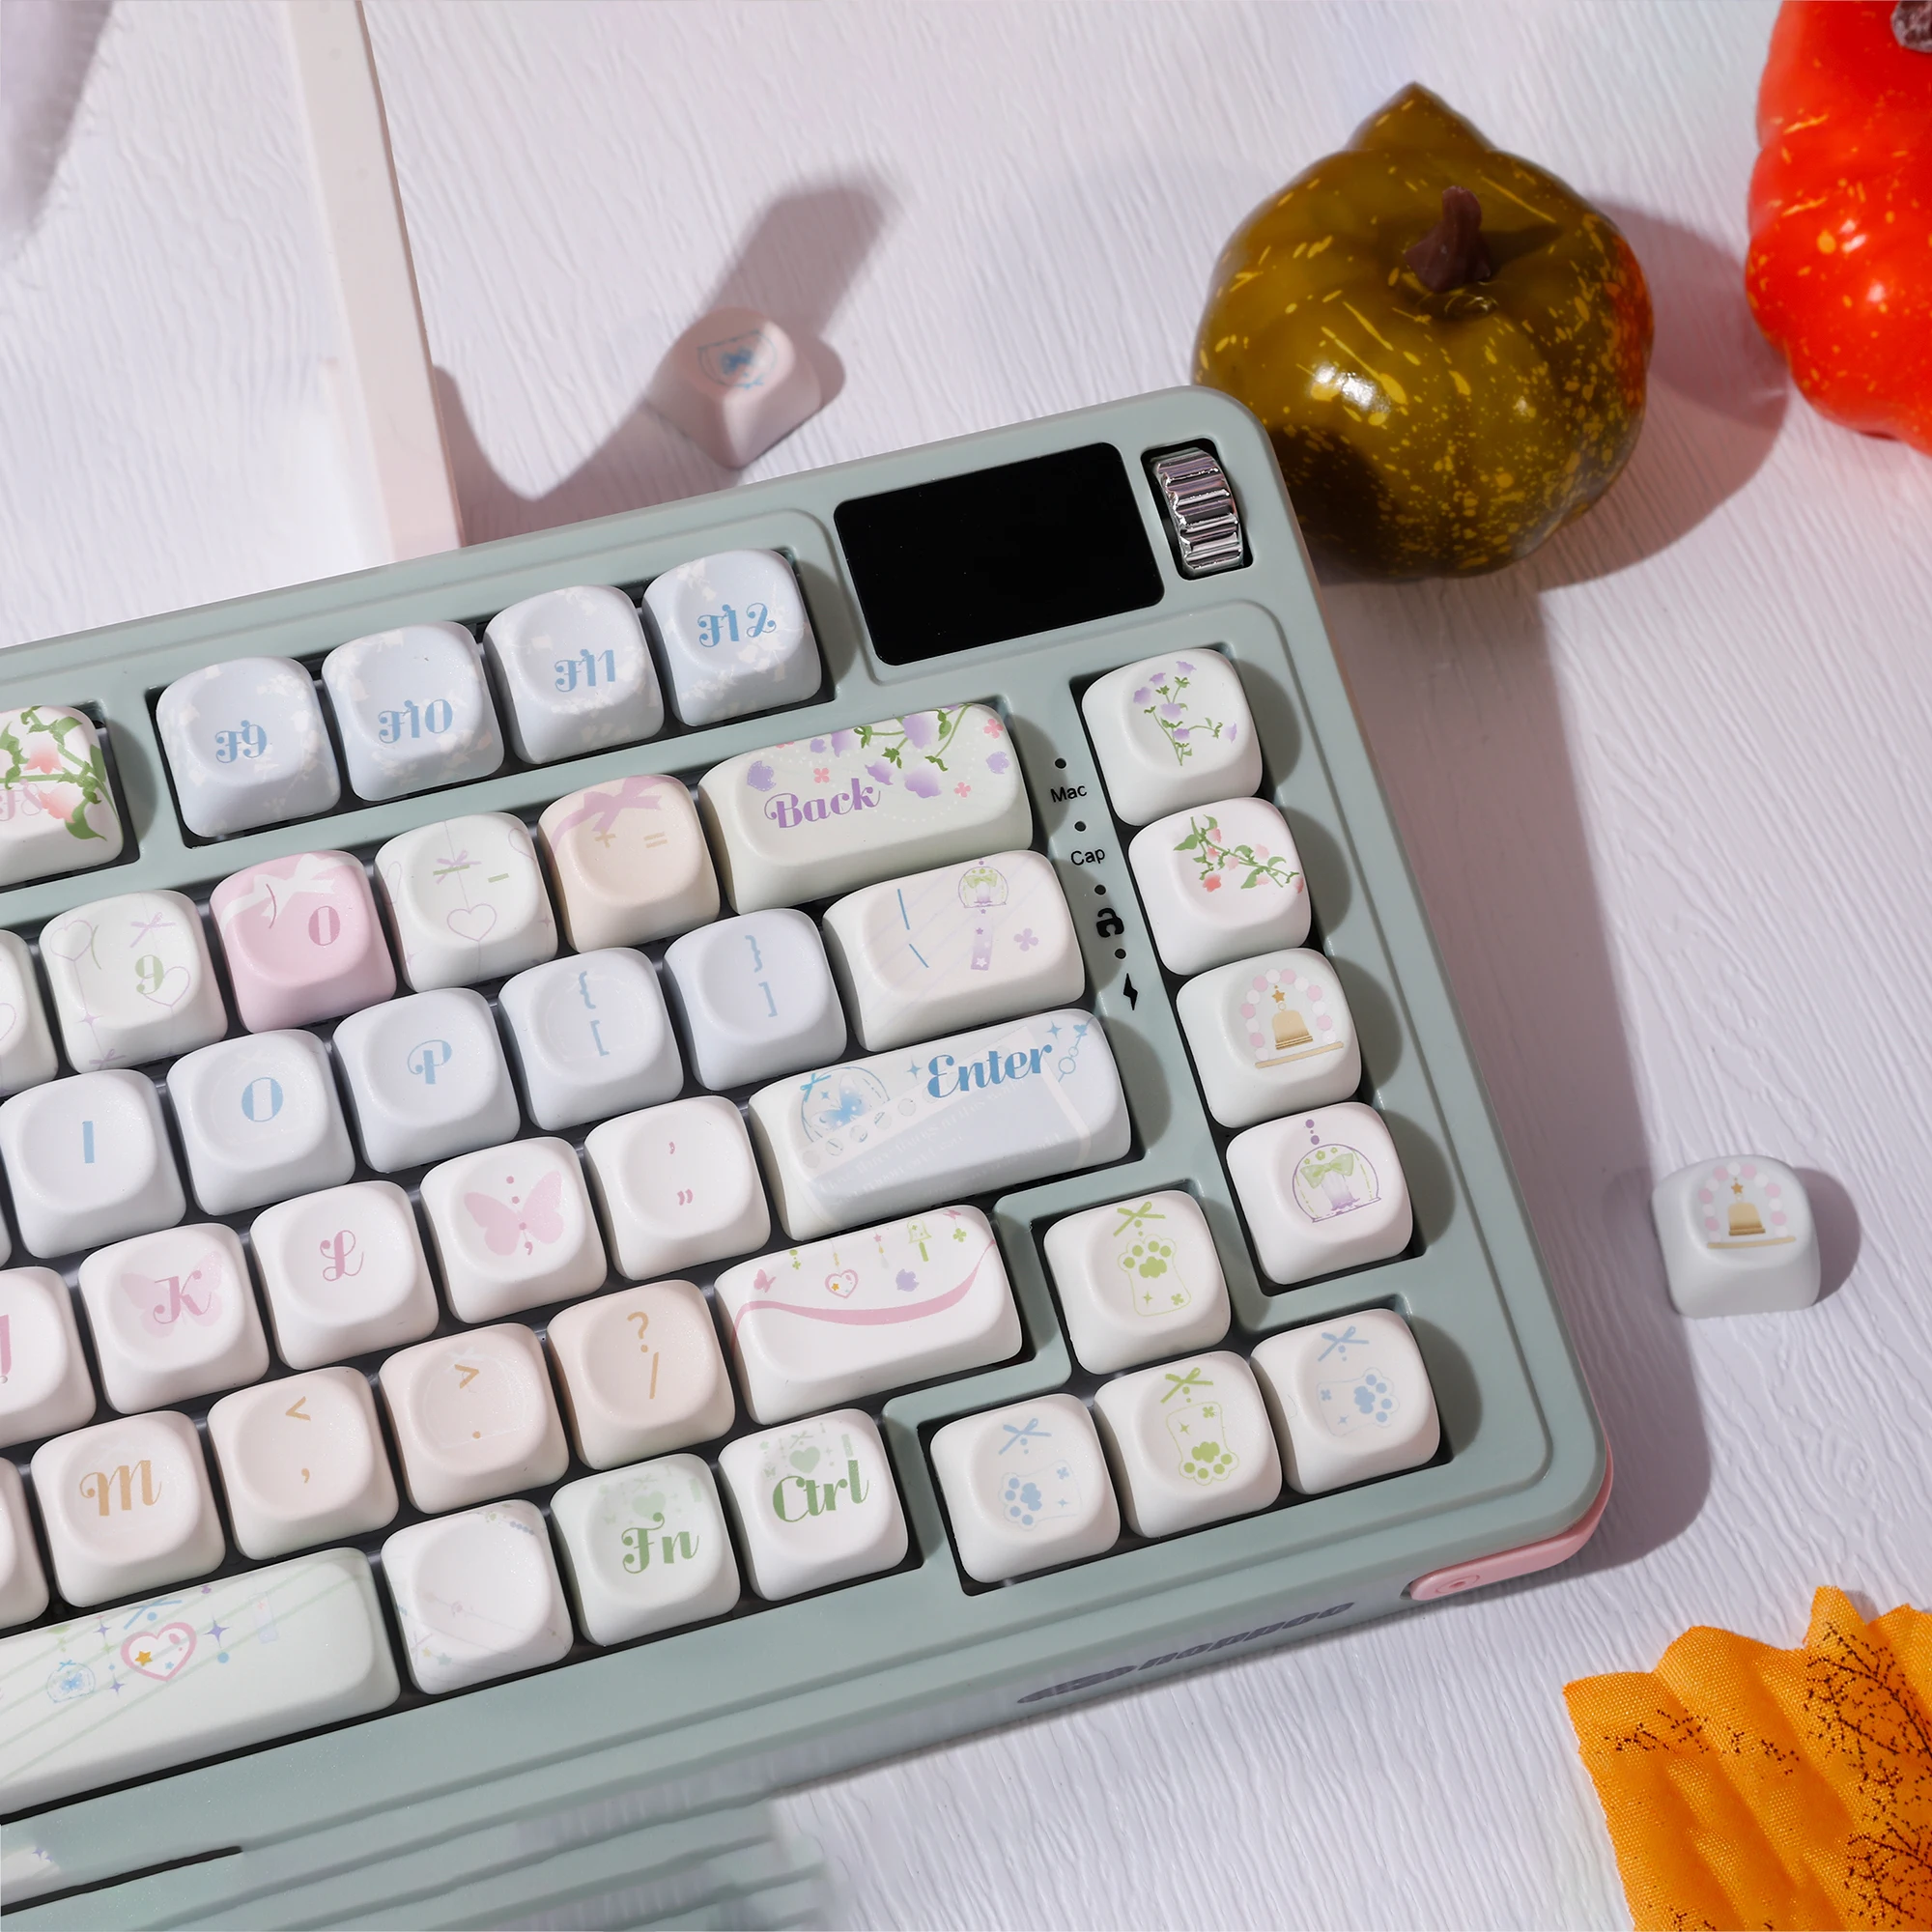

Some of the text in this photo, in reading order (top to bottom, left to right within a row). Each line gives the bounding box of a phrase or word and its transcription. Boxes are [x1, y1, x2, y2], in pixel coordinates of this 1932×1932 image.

[697, 603, 776, 647] F12
[554, 649, 615, 693] F11
[214, 720, 267, 763] F9
[378, 700, 453, 744] F10
[764, 778, 880, 829] Back
[1050, 784, 1088, 803] Mac
[1070, 848, 1106, 867] Cap
[266, 884, 276, 929] )
[135, 954, 164, 1000] 9
[407, 1039, 452, 1084] P
[927, 1043, 1052, 1098] Enter
[242, 1077, 283, 1122] O
[320, 1230, 363, 1282] L
[153, 1270, 210, 1325] K
[79, 1460, 162, 1517] M
[772, 1461, 868, 1522] Ctrl
[621, 1512, 698, 1574] Fn
